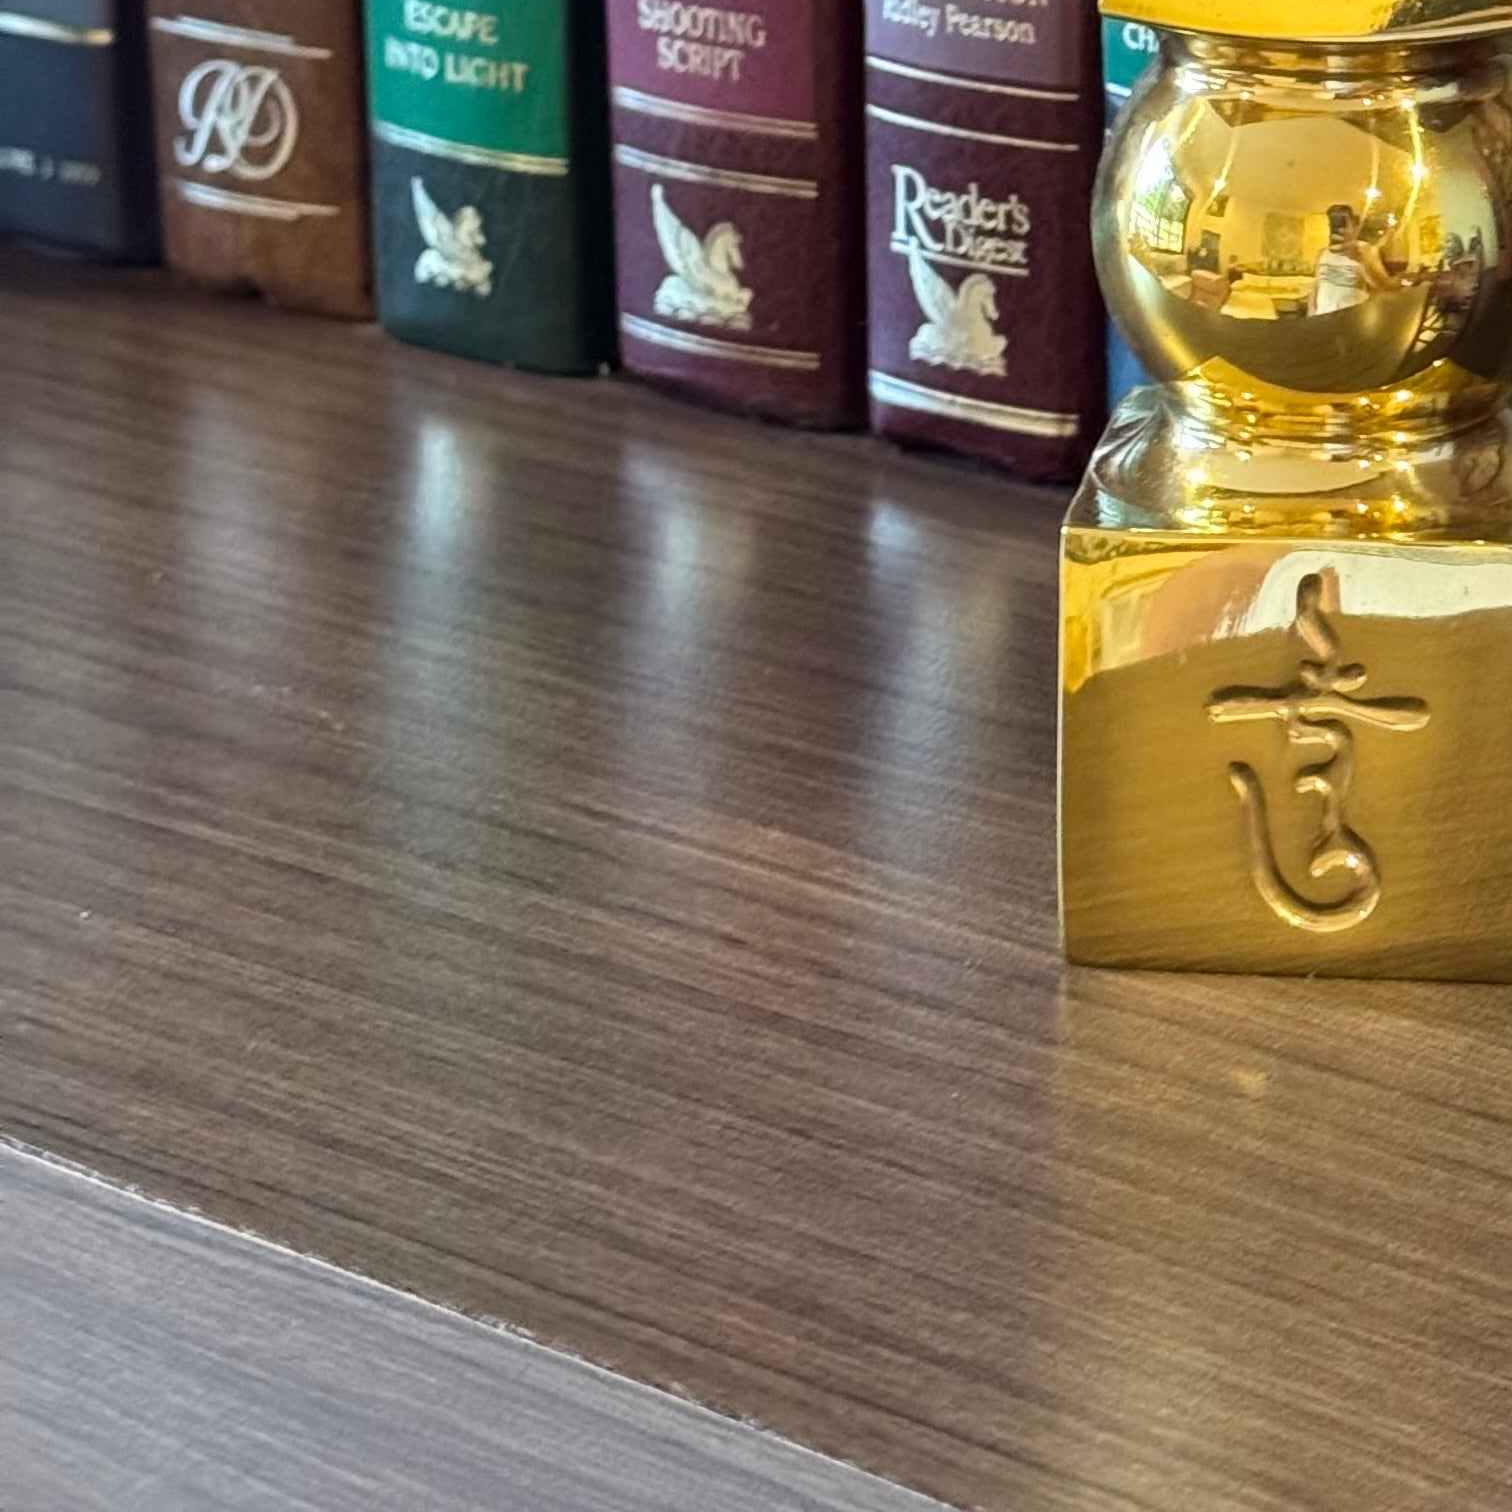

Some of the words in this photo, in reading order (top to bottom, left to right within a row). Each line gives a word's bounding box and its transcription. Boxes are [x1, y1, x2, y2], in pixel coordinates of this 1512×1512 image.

[945, 2, 1036, 45] Pearson
[383, 36, 439, 80] INTO
[444, 51, 530, 93] LIGHT
[657, 39, 743, 82] SCRIPT
[890, 163, 1030, 252] Reader's
